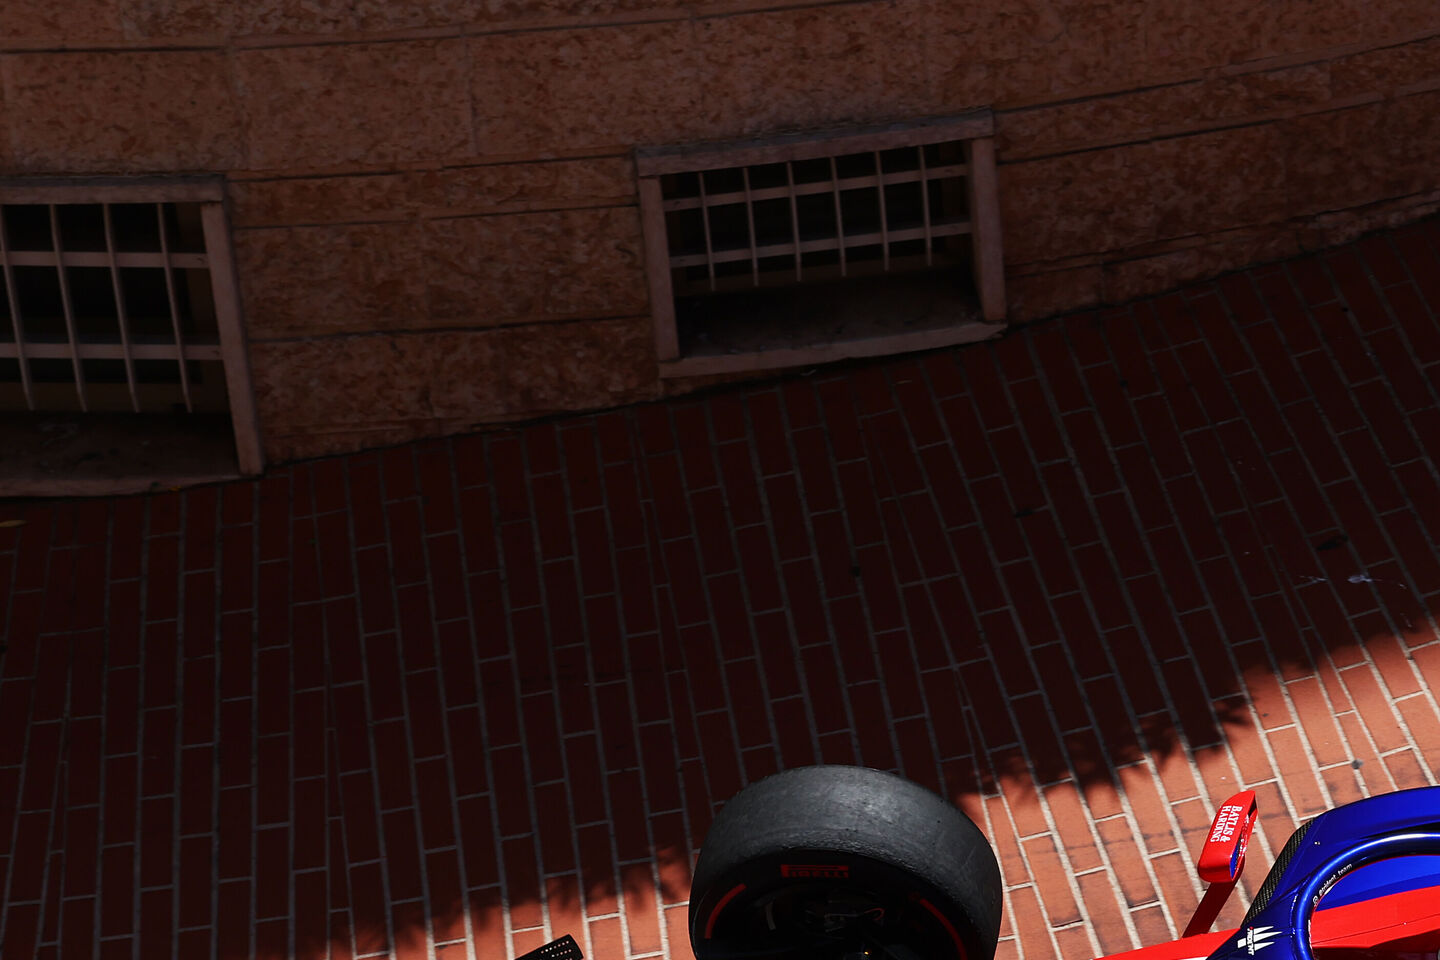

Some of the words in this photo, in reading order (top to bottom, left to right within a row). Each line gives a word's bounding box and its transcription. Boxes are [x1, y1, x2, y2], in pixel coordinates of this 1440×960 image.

[1210, 805, 1232, 843] HARDING
[1223, 805, 1243, 836] BAYLIS
[1220, 835, 1231, 843] &
[780, 864, 849, 879] PIRELLI
